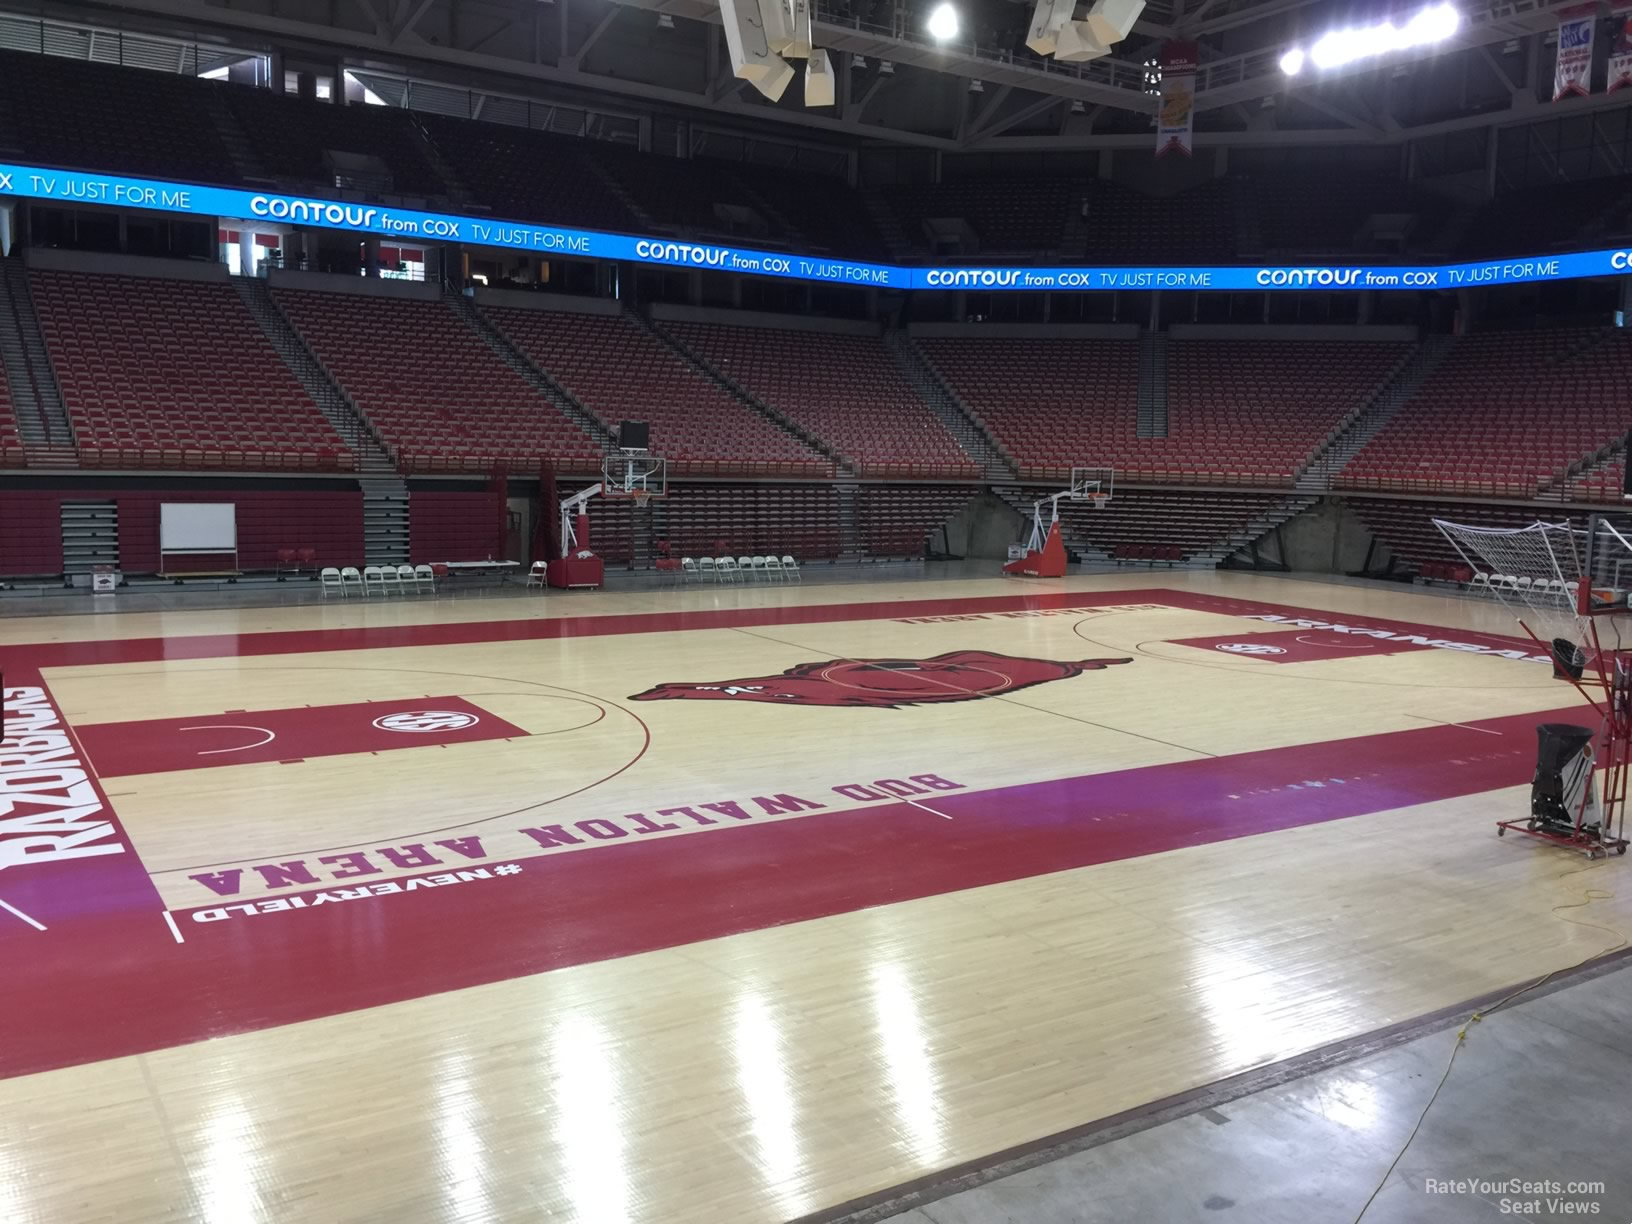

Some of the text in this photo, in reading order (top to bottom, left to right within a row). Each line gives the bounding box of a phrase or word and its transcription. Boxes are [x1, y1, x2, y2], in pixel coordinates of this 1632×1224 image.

[29, 175, 56, 193] TV
[61, 181, 109, 200] JUST
[114, 184, 157, 205] FOR
[161, 190, 192, 208] ME
[381, 213, 418, 233] from
[422, 219, 460, 237] COX
[471, 224, 491, 241] TV
[495, 228, 530, 245] JUST
[533, 232, 566, 249] FOR
[568, 236, 590, 252] ME
[732, 253, 760, 271] from
[762, 257, 791, 274] COX
[799, 262, 815, 276] TV
[816, 264, 844, 279] JUST
[846, 267, 870, 281] FOR
[872, 269, 889, 283] ME
[1024, 272, 1055, 286] from
[1057, 273, 1090, 287] COX
[1100, 273, 1118, 286] TV
[1120, 273, 1154, 286] JUST
[1157, 273, 1187, 286] FOR
[1189, 273, 1211, 286] ME
[1366, 271, 1399, 286] from
[1402, 272, 1438, 286] COX
[1448, 270, 1466, 284] TV
[1467, 266, 1501, 282] JUST
[1503, 263, 1534, 279] FOR
[1536, 260, 1560, 276] ME
[188, 773, 968, 896] BUD WALTON ARENA
[191, 863, 524, 923] #NEVERYIELD
